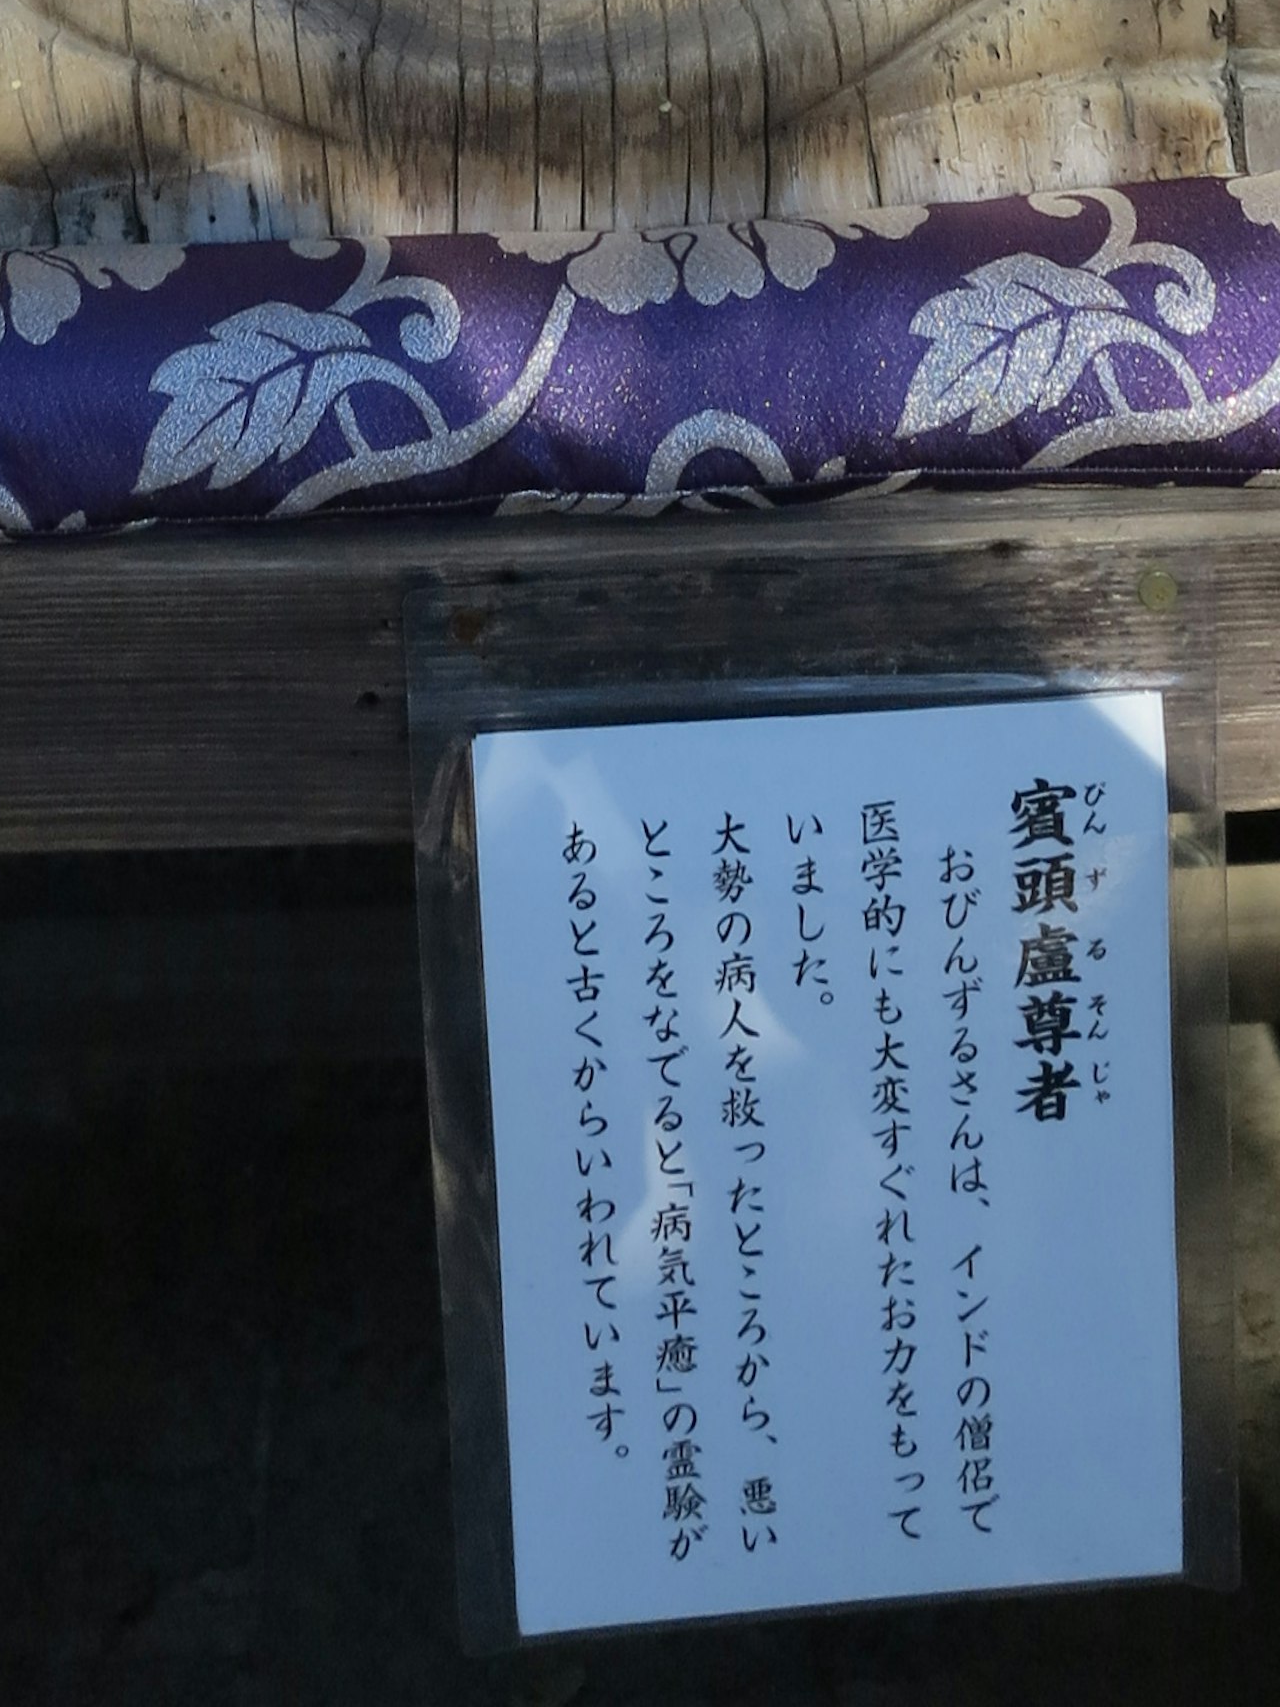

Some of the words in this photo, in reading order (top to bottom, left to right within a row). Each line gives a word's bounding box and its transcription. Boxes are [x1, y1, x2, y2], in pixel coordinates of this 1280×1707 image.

[561, 821, 631, 1459] あると古くからいわれています。
[785, 813, 836, 1008] いました。
[859, 799, 927, 1541] 医学的にも大変すぐれたお力をもって
